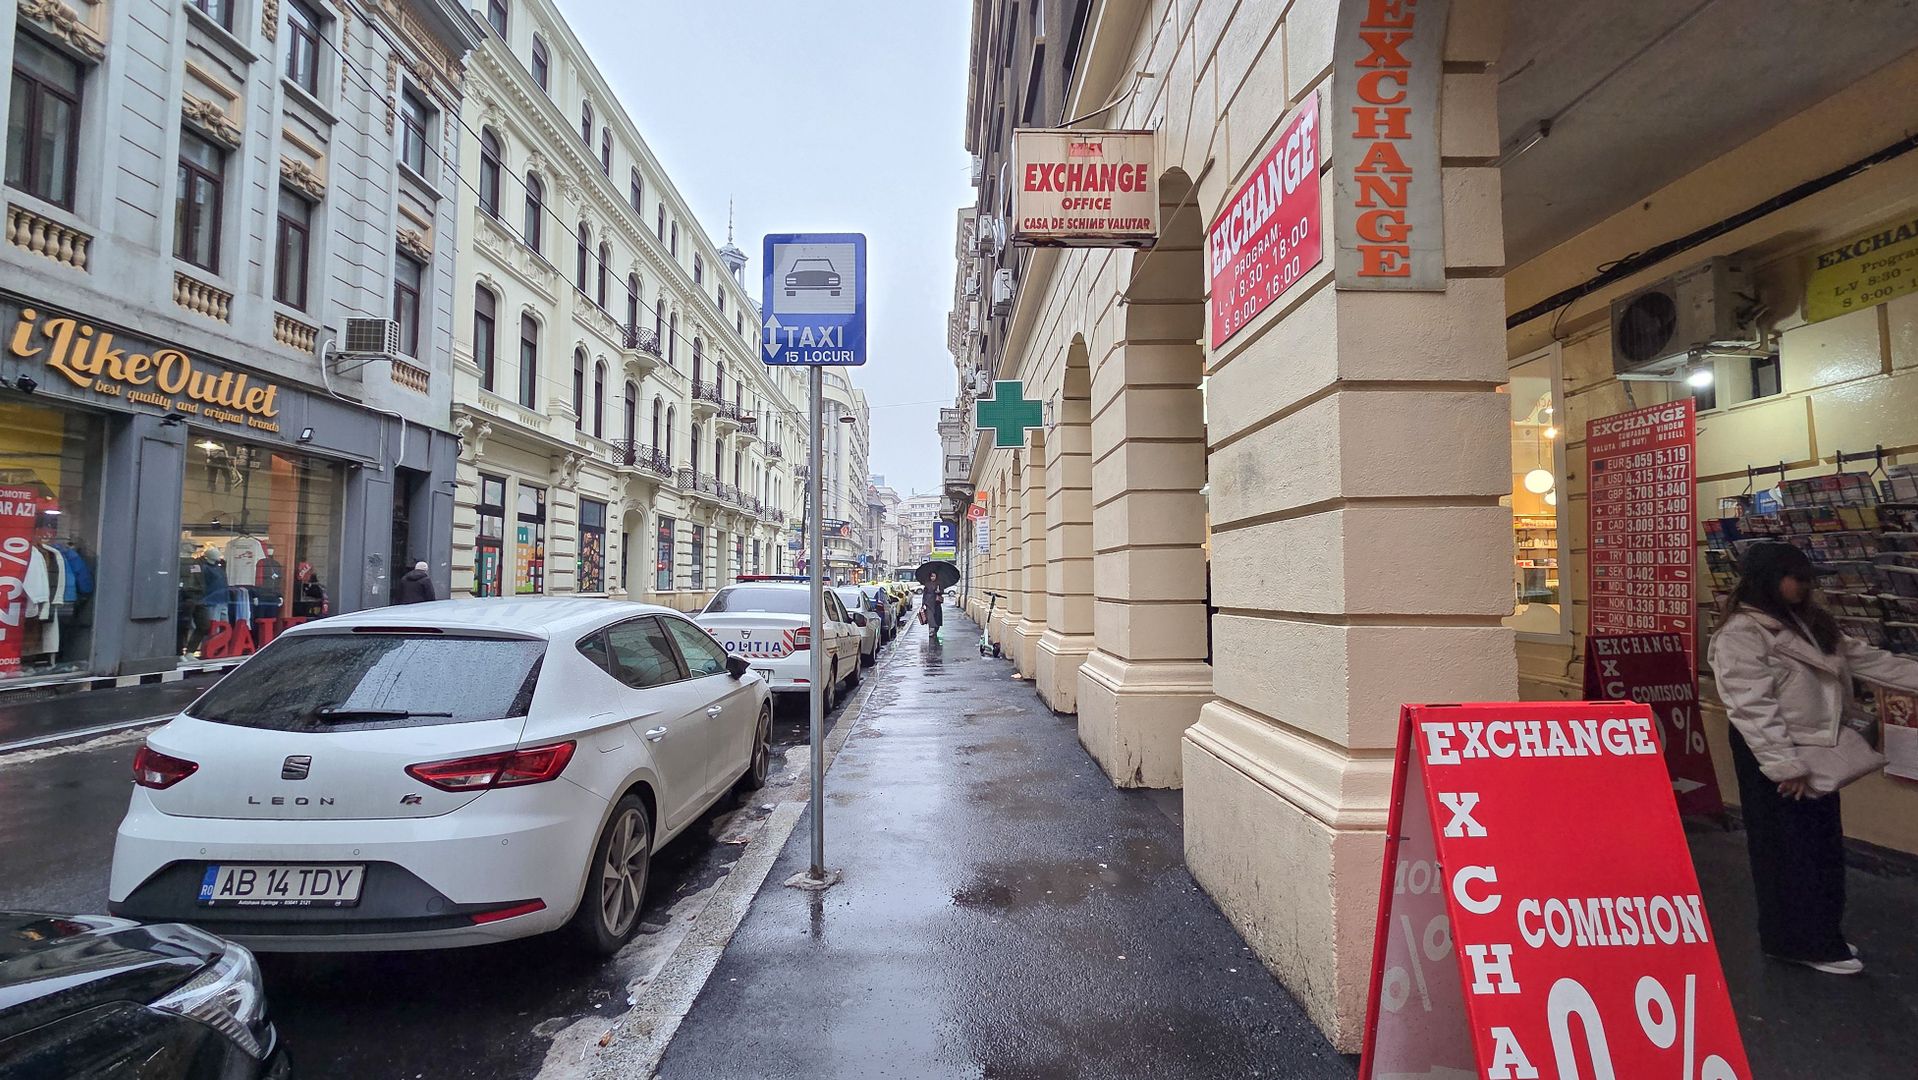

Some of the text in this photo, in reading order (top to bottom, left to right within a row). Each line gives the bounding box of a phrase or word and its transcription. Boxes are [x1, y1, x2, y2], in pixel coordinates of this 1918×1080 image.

[1352, 0, 1416, 277] EXCHANGE
[1024, 163, 1148, 192] EXCHANGE
[1213, 109, 1315, 278] EXCHANGE
[1061, 197, 1111, 210] OFFICE
[1024, 218, 1150, 230] CASA DE SCHIMB VALUTAR
[1234, 223, 1282, 280] PROGRAM:
[1239, 262, 1263, 298] 8:30
[1272, 216, 1308, 266] 18:00
[1224, 318, 1231, 336] S
[1234, 295, 1256, 327] 9:00
[1265, 256, 1300, 296] 16:00
[1842, 298, 1852, 308] S
[1861, 286, 1893, 303] 9:00
[783, 326, 843, 348] TAXI
[784, 350, 854, 363] 15 LOCURI
[95, 380, 280, 433] best quality and original brands
[1592, 406, 1686, 437] EXCHANGE
[1656, 421, 1684, 433] VINDEM
[1592, 443, 1616, 453] VALUTA
[1608, 460, 1624, 469] EUR
[1608, 473, 1623, 484] USD
[1608, 489, 1623, 499] GBP
[15, 502, 36, 517] AZI
[1607, 505, 1622, 515] CHF
[1608, 520, 1624, 530] CAD
[1608, 535, 1623, 545] ILS
[1609, 551, 1623, 560] TRY
[1609, 567, 1624, 576] SEK
[1609, 582, 1624, 591] MDL
[1609, 598, 1625, 608] NOK
[1609, 613, 1624, 624] DKK
[719, 641, 782, 653] OLITIA
[1596, 636, 1682, 655] EXCHANGE
[1632, 683, 1694, 702] COMISION
[1421, 718, 1657, 766] EXCHANGE
[248, 796, 335, 806] LEON
[219, 869, 353, 896] AB 14 TDY
[200, 885, 214, 896] RO
[1516, 895, 1709, 949] COMISION
